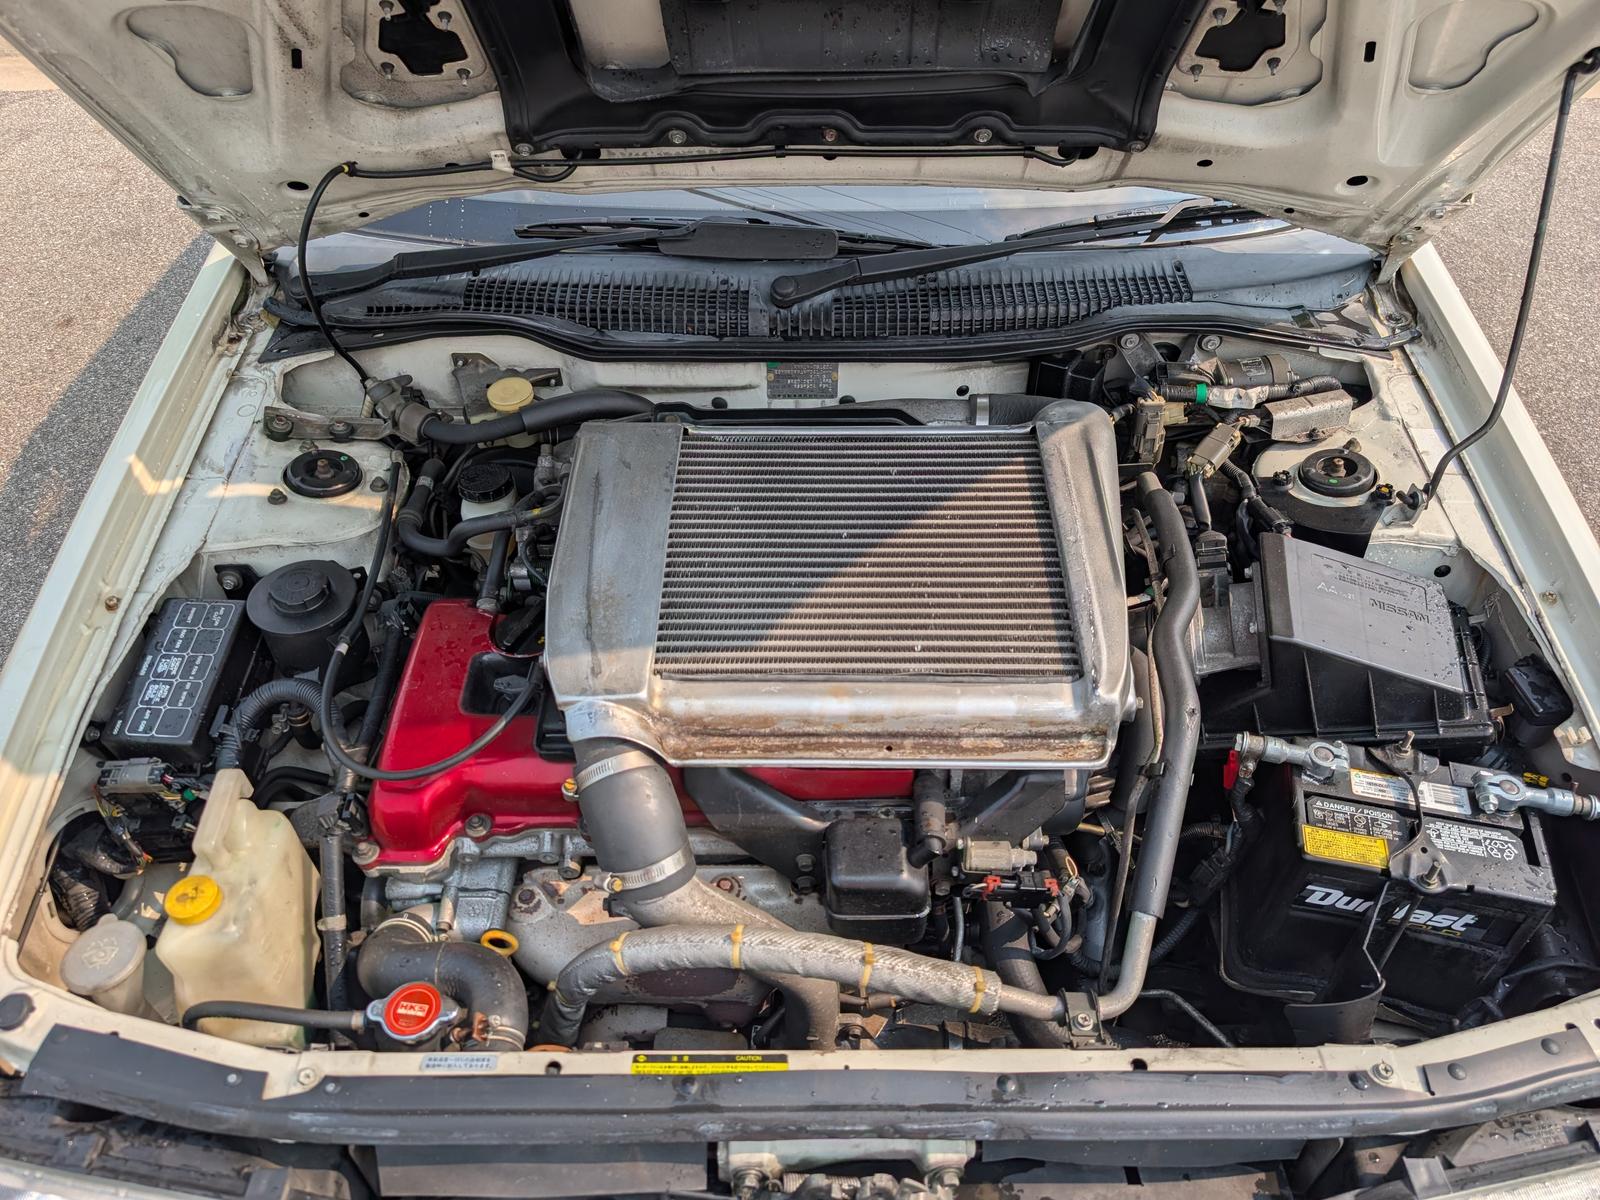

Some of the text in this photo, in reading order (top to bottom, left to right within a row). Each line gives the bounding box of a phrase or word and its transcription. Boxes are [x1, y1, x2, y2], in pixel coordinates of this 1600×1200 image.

[1369, 598, 1430, 624] NISSAN
[1323, 802, 1356, 812] DANGER
[1363, 809, 1393, 819] POISON
[400, 1003, 426, 1011] HKS
